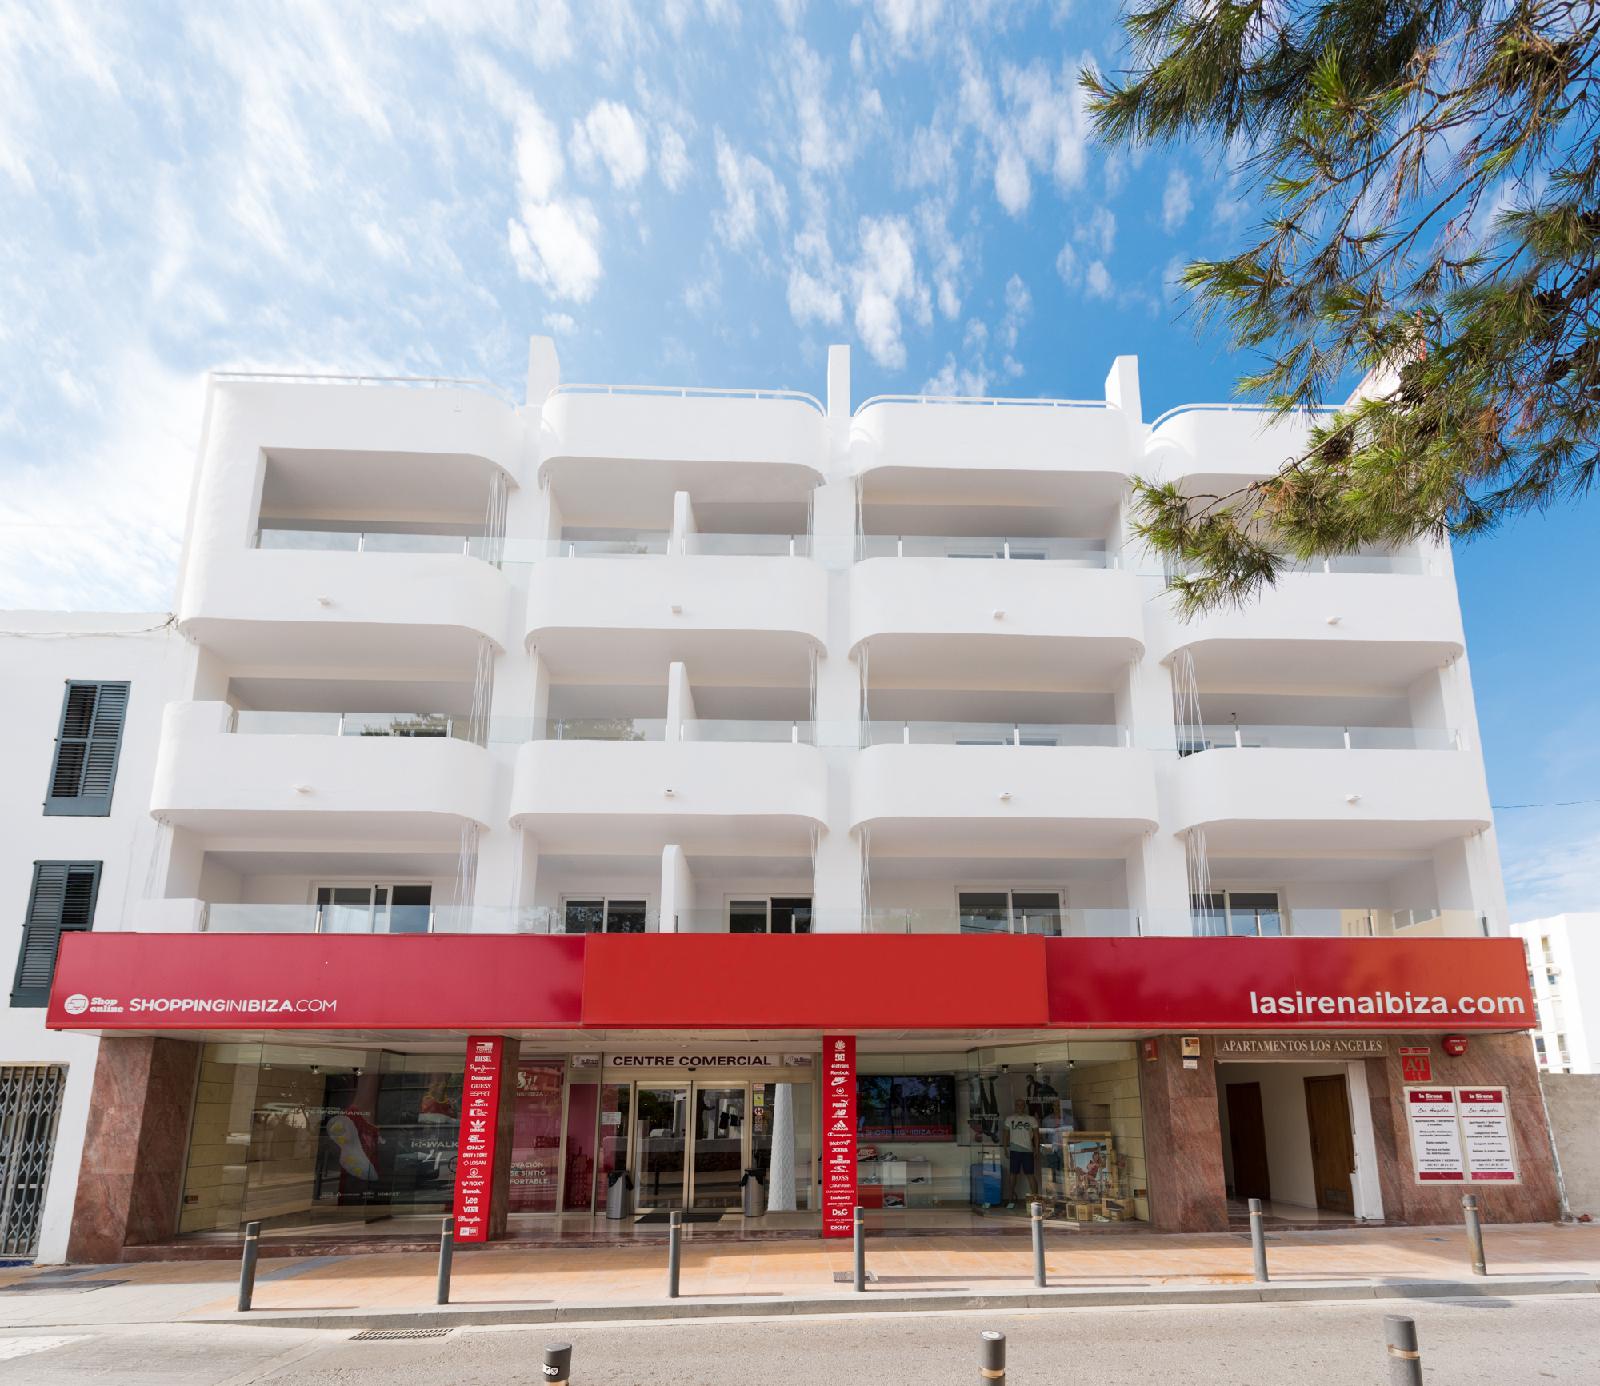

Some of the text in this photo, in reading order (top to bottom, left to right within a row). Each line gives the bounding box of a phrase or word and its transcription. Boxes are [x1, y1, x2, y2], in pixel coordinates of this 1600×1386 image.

[91, 997, 118, 1005] Shop
[129, 998, 337, 1012] SHOPPINGINIBIZA.COM
[1250, 991, 1526, 1014] lasirenaibiza.com
[90, 1005, 124, 1013] online
[1222, 1040, 1383, 1051] APARTAMENTOS LOS ANGELES
[613, 1056, 771, 1066] CENTRE COMERCIAL
[1405, 1058, 1427, 1072] AT
[1011, 1120, 1031, 1130] Lee
